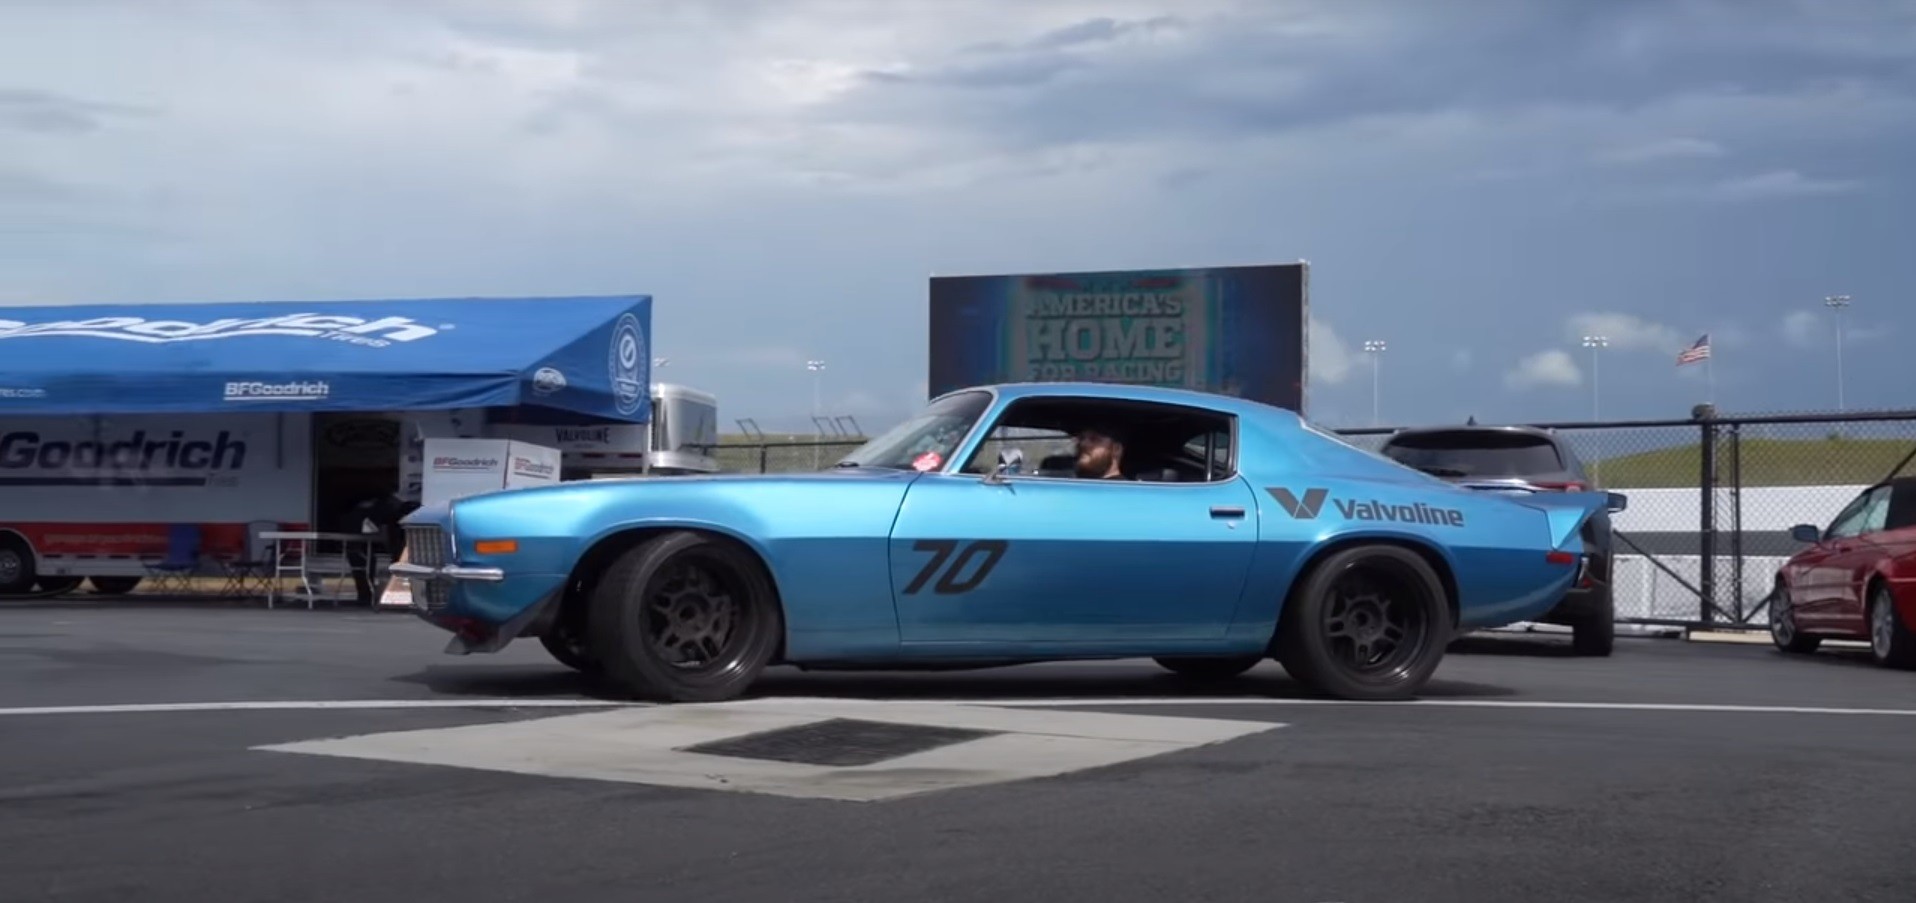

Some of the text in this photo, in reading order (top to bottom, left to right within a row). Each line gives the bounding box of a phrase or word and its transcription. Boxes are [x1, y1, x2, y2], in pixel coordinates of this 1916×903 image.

[1027, 293, 1182, 316] AMERICA'S
[1027, 317, 1183, 360] HOME
[1029, 360, 1182, 381] FOR RACING
[224, 381, 329, 396] BFGoodrich
[556, 427, 610, 444] VALVOLINE
[432, 456, 498, 467] BFGoodrich
[1333, 498, 1465, 528] Valvoline
[903, 540, 1009, 594] 70
